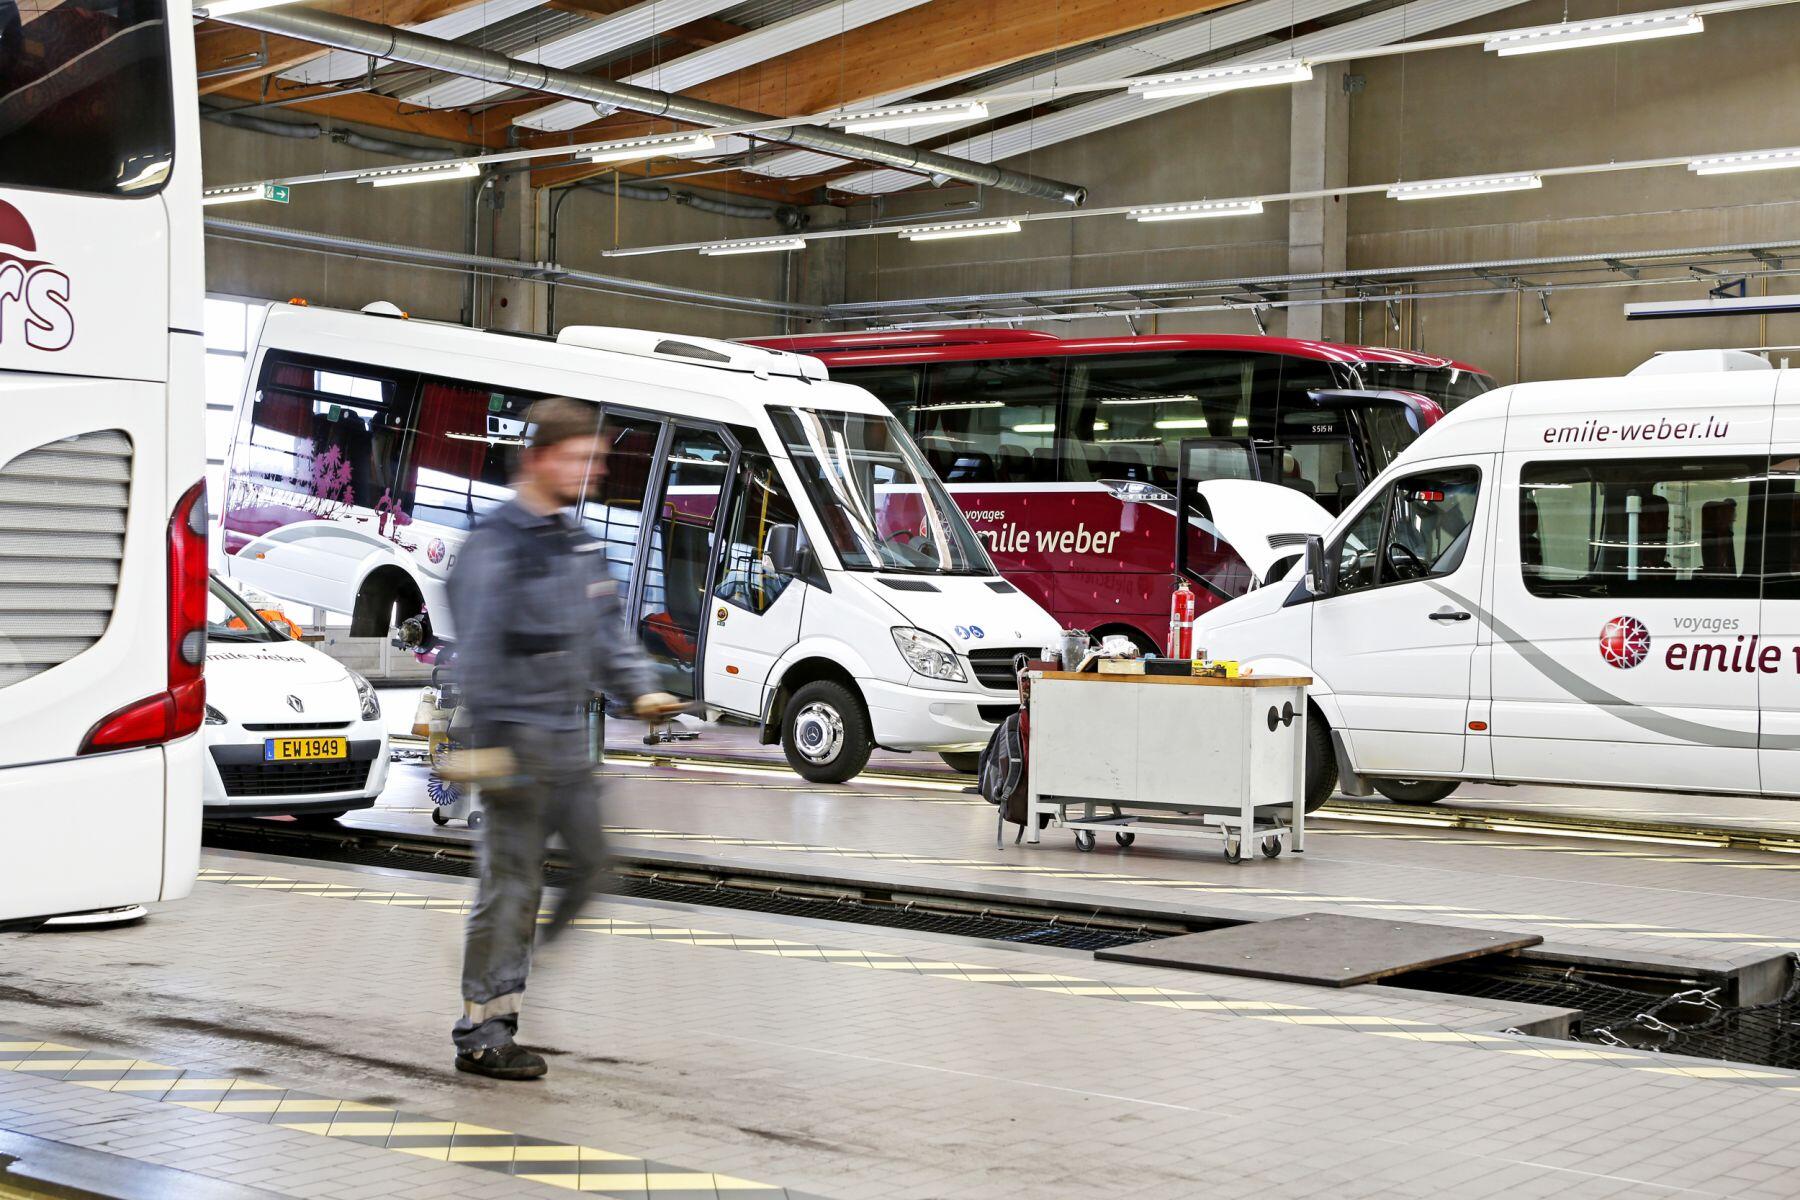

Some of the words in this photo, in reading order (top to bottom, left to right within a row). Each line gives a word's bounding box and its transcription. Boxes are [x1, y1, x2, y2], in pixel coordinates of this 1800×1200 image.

[1543, 415, 1729, 443] emile-weber.lu
[965, 509, 1005, 523] voyages
[976, 522, 1031, 553] mile
[1035, 522, 1121, 554] weber
[1673, 616, 1740, 633] voyages
[205, 652, 249, 661] mile
[1665, 634, 1782, 674] emile
[305, 740, 338, 757] 1949
